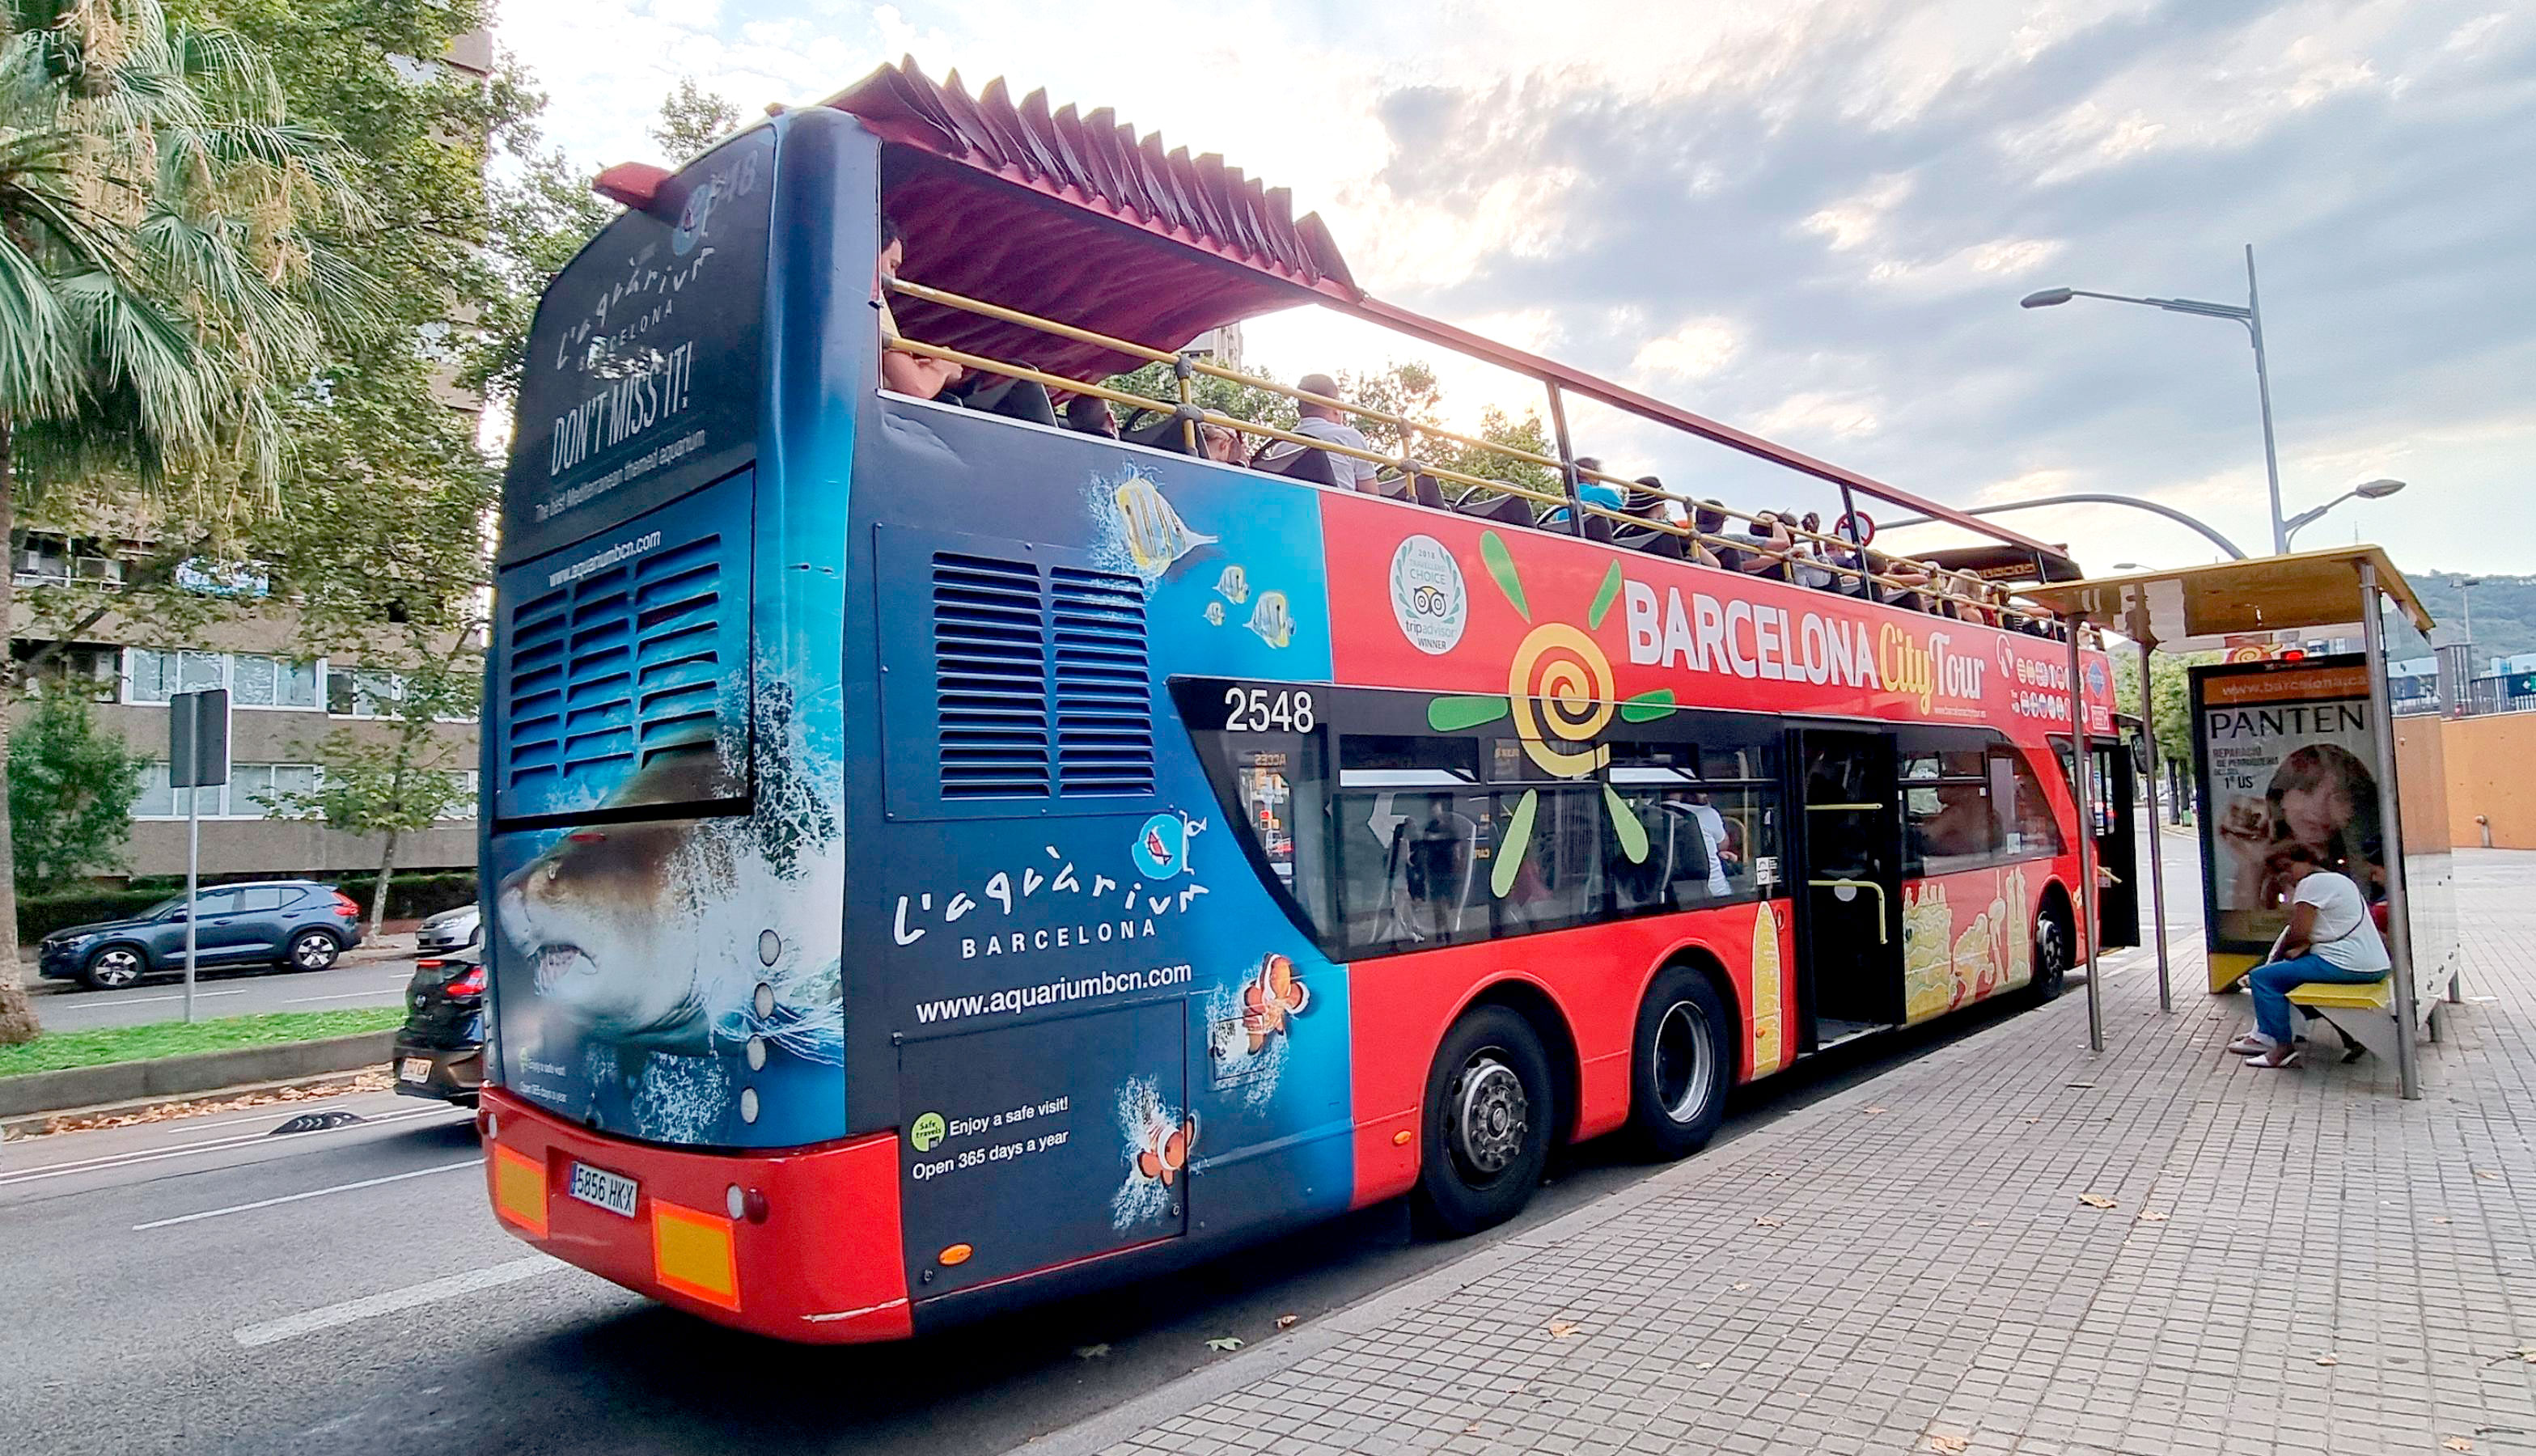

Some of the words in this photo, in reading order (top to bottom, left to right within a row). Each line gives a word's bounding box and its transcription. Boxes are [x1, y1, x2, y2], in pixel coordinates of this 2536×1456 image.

[551, 391, 608, 476] DON'T
[608, 364, 661, 447] MISS
[663, 341, 692, 418] IT!
[549, 531, 661, 587] www.aquariumbcn.com
[1410, 568, 1446, 585] CHOICE
[1405, 620, 1455, 638] tripadvisor
[1417, 637, 1447, 650] WINNER
[1624, 579, 1879, 690] BARCELONA
[2222, 675, 2369, 696] www.barcelona.ca
[1224, 688, 1315, 734] 2548
[2210, 704, 2365, 739] PANTEN
[961, 918, 1156, 960] BARCELONA
[915, 963, 1192, 1024] www.aquariumbcn.com
[916, 1127, 942, 1138] travels
[919, 1120, 937, 1131] Safe
[949, 1117, 989, 1136] Enjoy
[993, 1115, 1002, 1126] a
[1006, 1105, 1035, 1124] safe
[1039, 1096, 1069, 1115] visit!
[912, 1158, 954, 1180] Open
[958, 1149, 985, 1168] 365
[989, 1141, 1022, 1160] days
[1027, 1140, 1036, 1152] a
[1039, 1131, 1069, 1150] year
[578, 1168, 606, 1202] 5856
[608, 1179, 633, 1212] HKX
